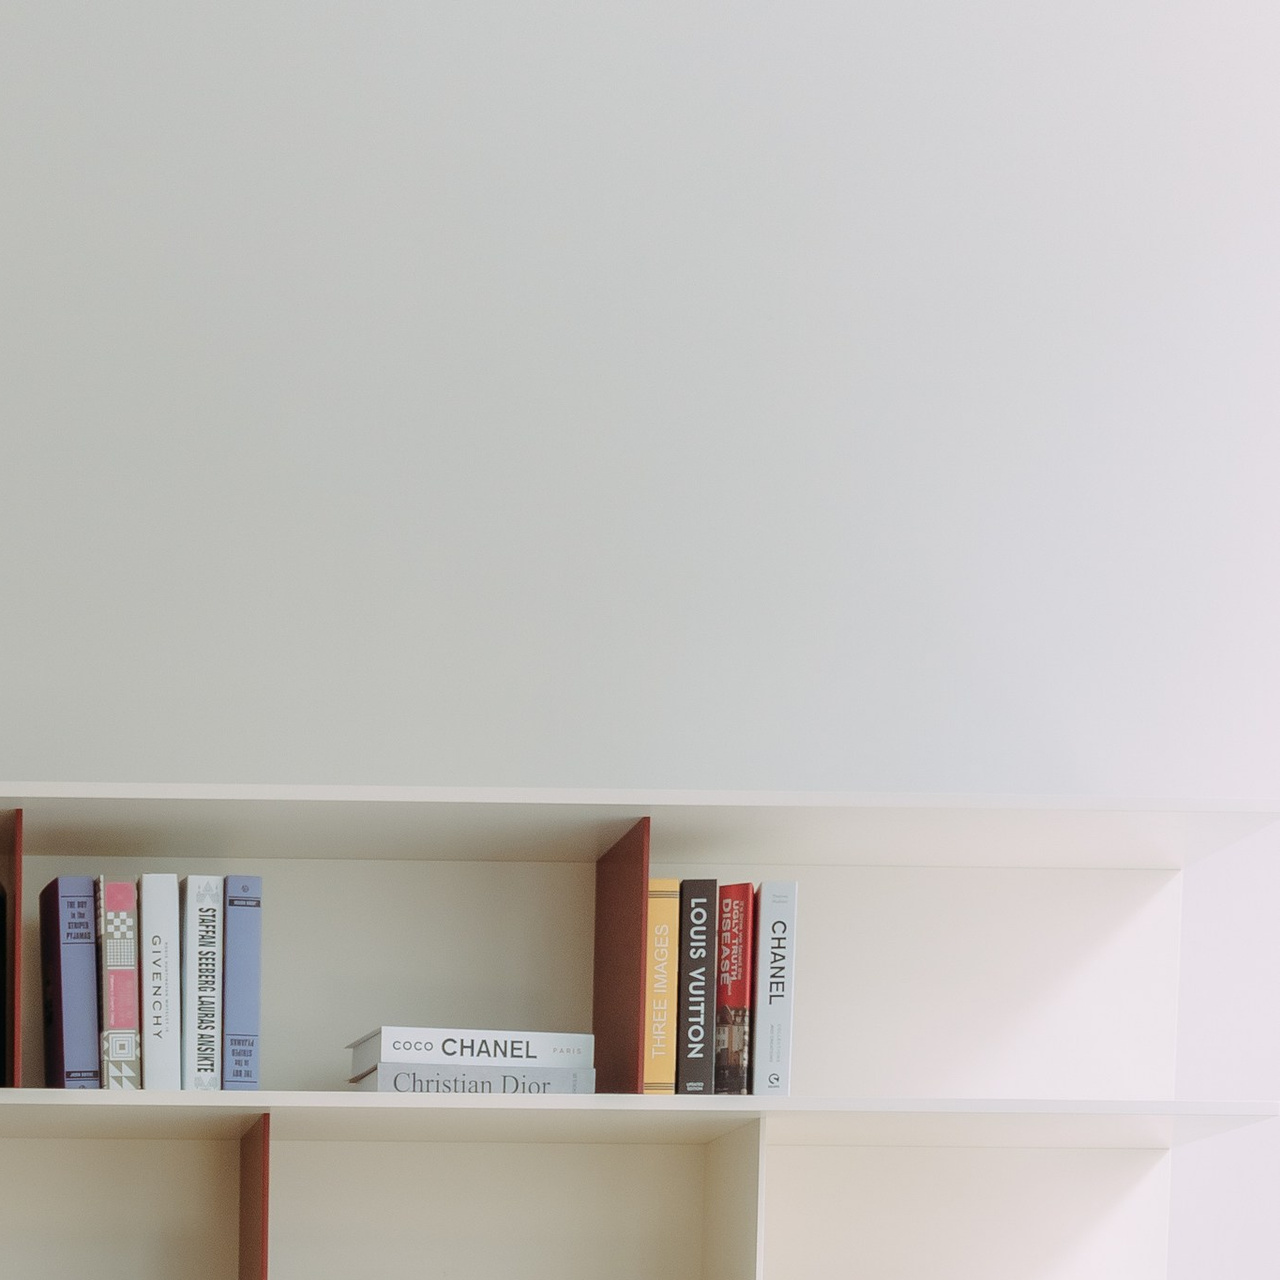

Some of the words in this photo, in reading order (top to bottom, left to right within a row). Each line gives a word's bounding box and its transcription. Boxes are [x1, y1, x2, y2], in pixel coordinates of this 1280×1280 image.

[66, 931, 91, 940] PYJAMAS
[198, 907, 216, 948] STAFFAN
[690, 898, 707, 960] LOUIS
[720, 898, 731, 985] DISEASE
[198, 950, 216, 992] SEEBERG
[653, 924, 669, 993] IMAGES
[730, 937, 738, 981] TRUTH
[769, 920, 787, 1005] CHANEL
[152, 935, 163, 1039] GIVENCHY
[198, 995, 216, 1031] LAURAS
[652, 999, 667, 1059] THREE
[687, 967, 706, 1058] VUITTON
[197, 1033, 215, 1073] ANSIKTE
[441, 1038, 538, 1059] CHANEL
[552, 1047, 582, 1055] PARIS
[393, 1072, 492, 1093] Christian
[501, 1074, 551, 1094] Dior
